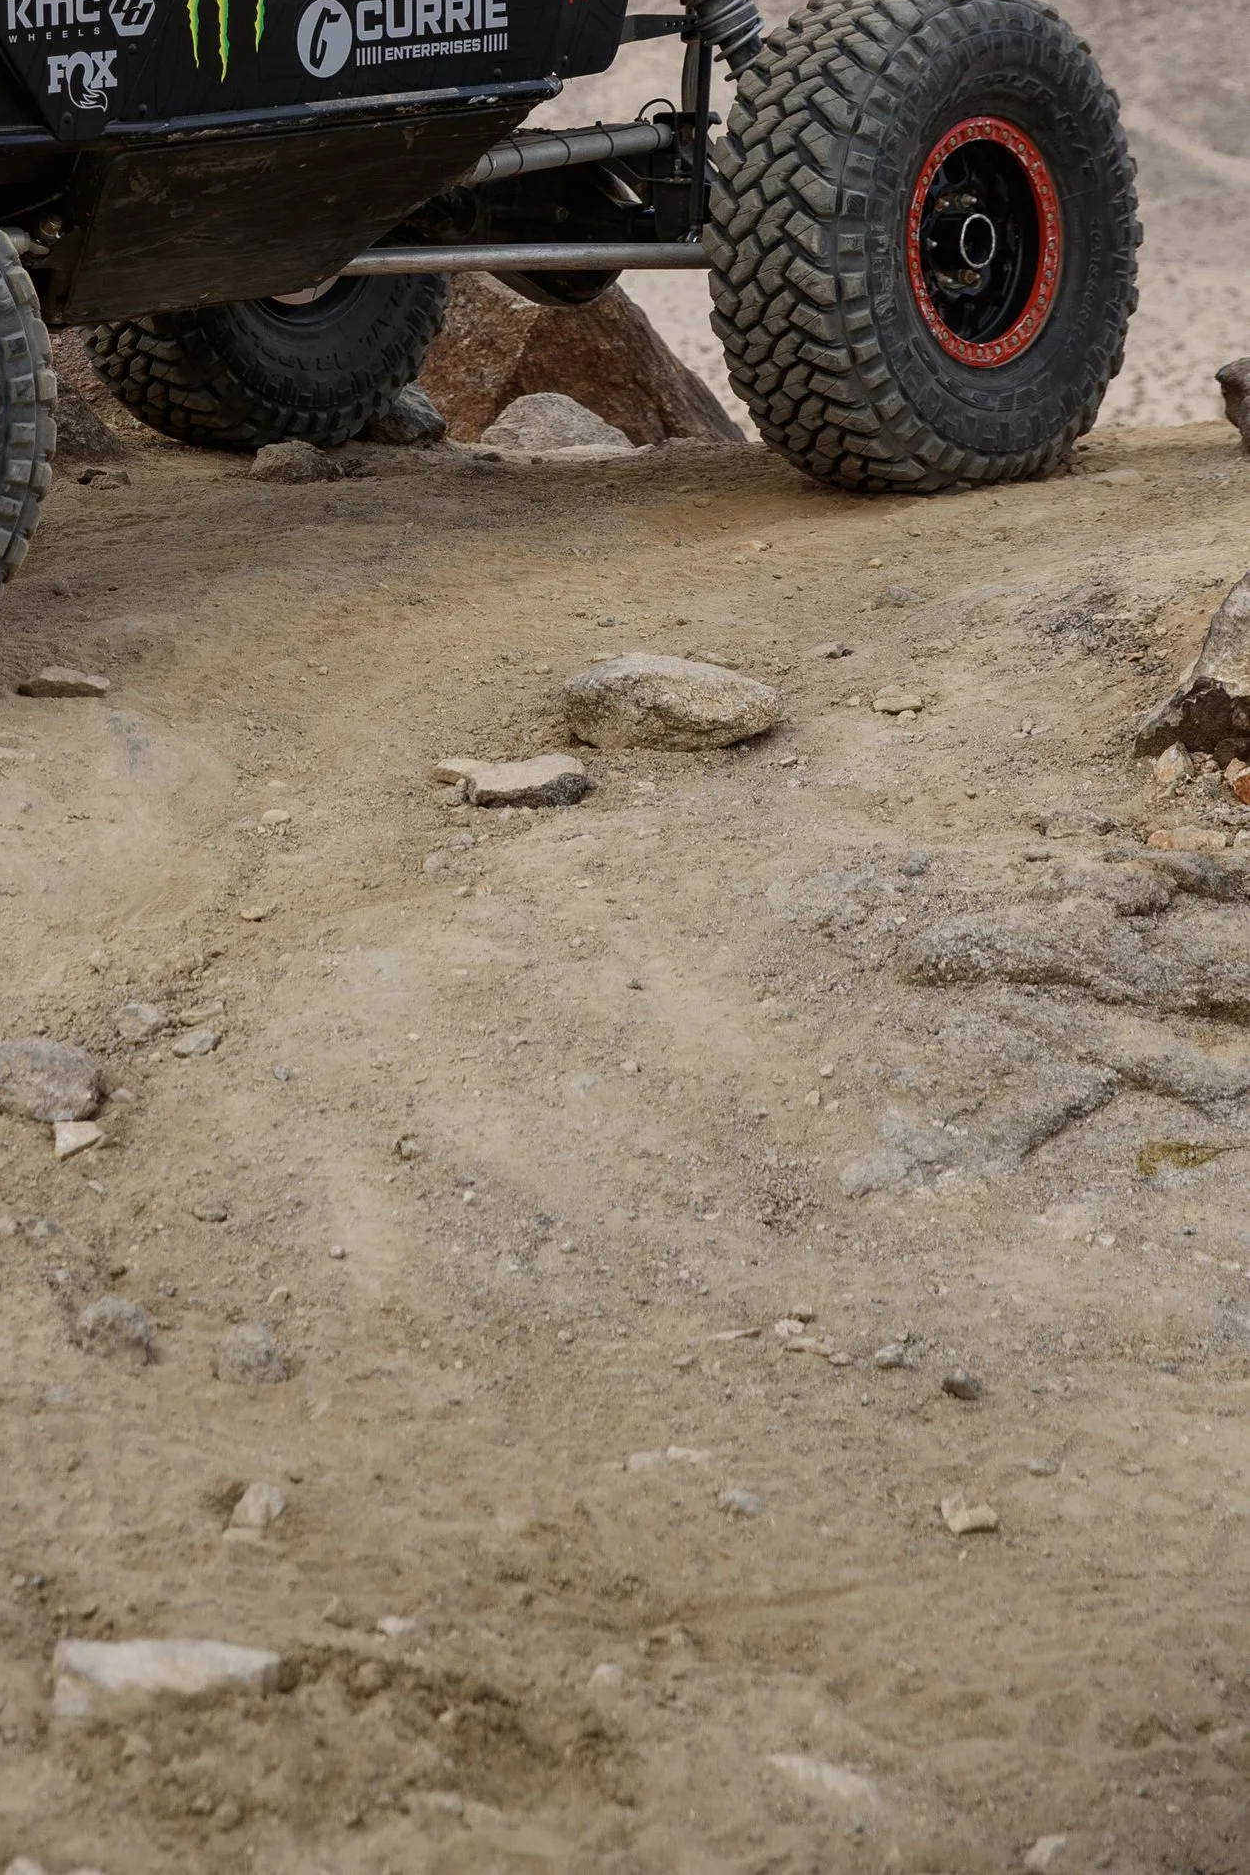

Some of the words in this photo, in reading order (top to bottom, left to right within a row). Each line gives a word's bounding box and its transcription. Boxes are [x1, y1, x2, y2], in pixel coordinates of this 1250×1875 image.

[8, 26, 101, 44] WHEELS
[384, 37, 482, 62] ENTERPRISES
[47, 49, 118, 112] FOX
